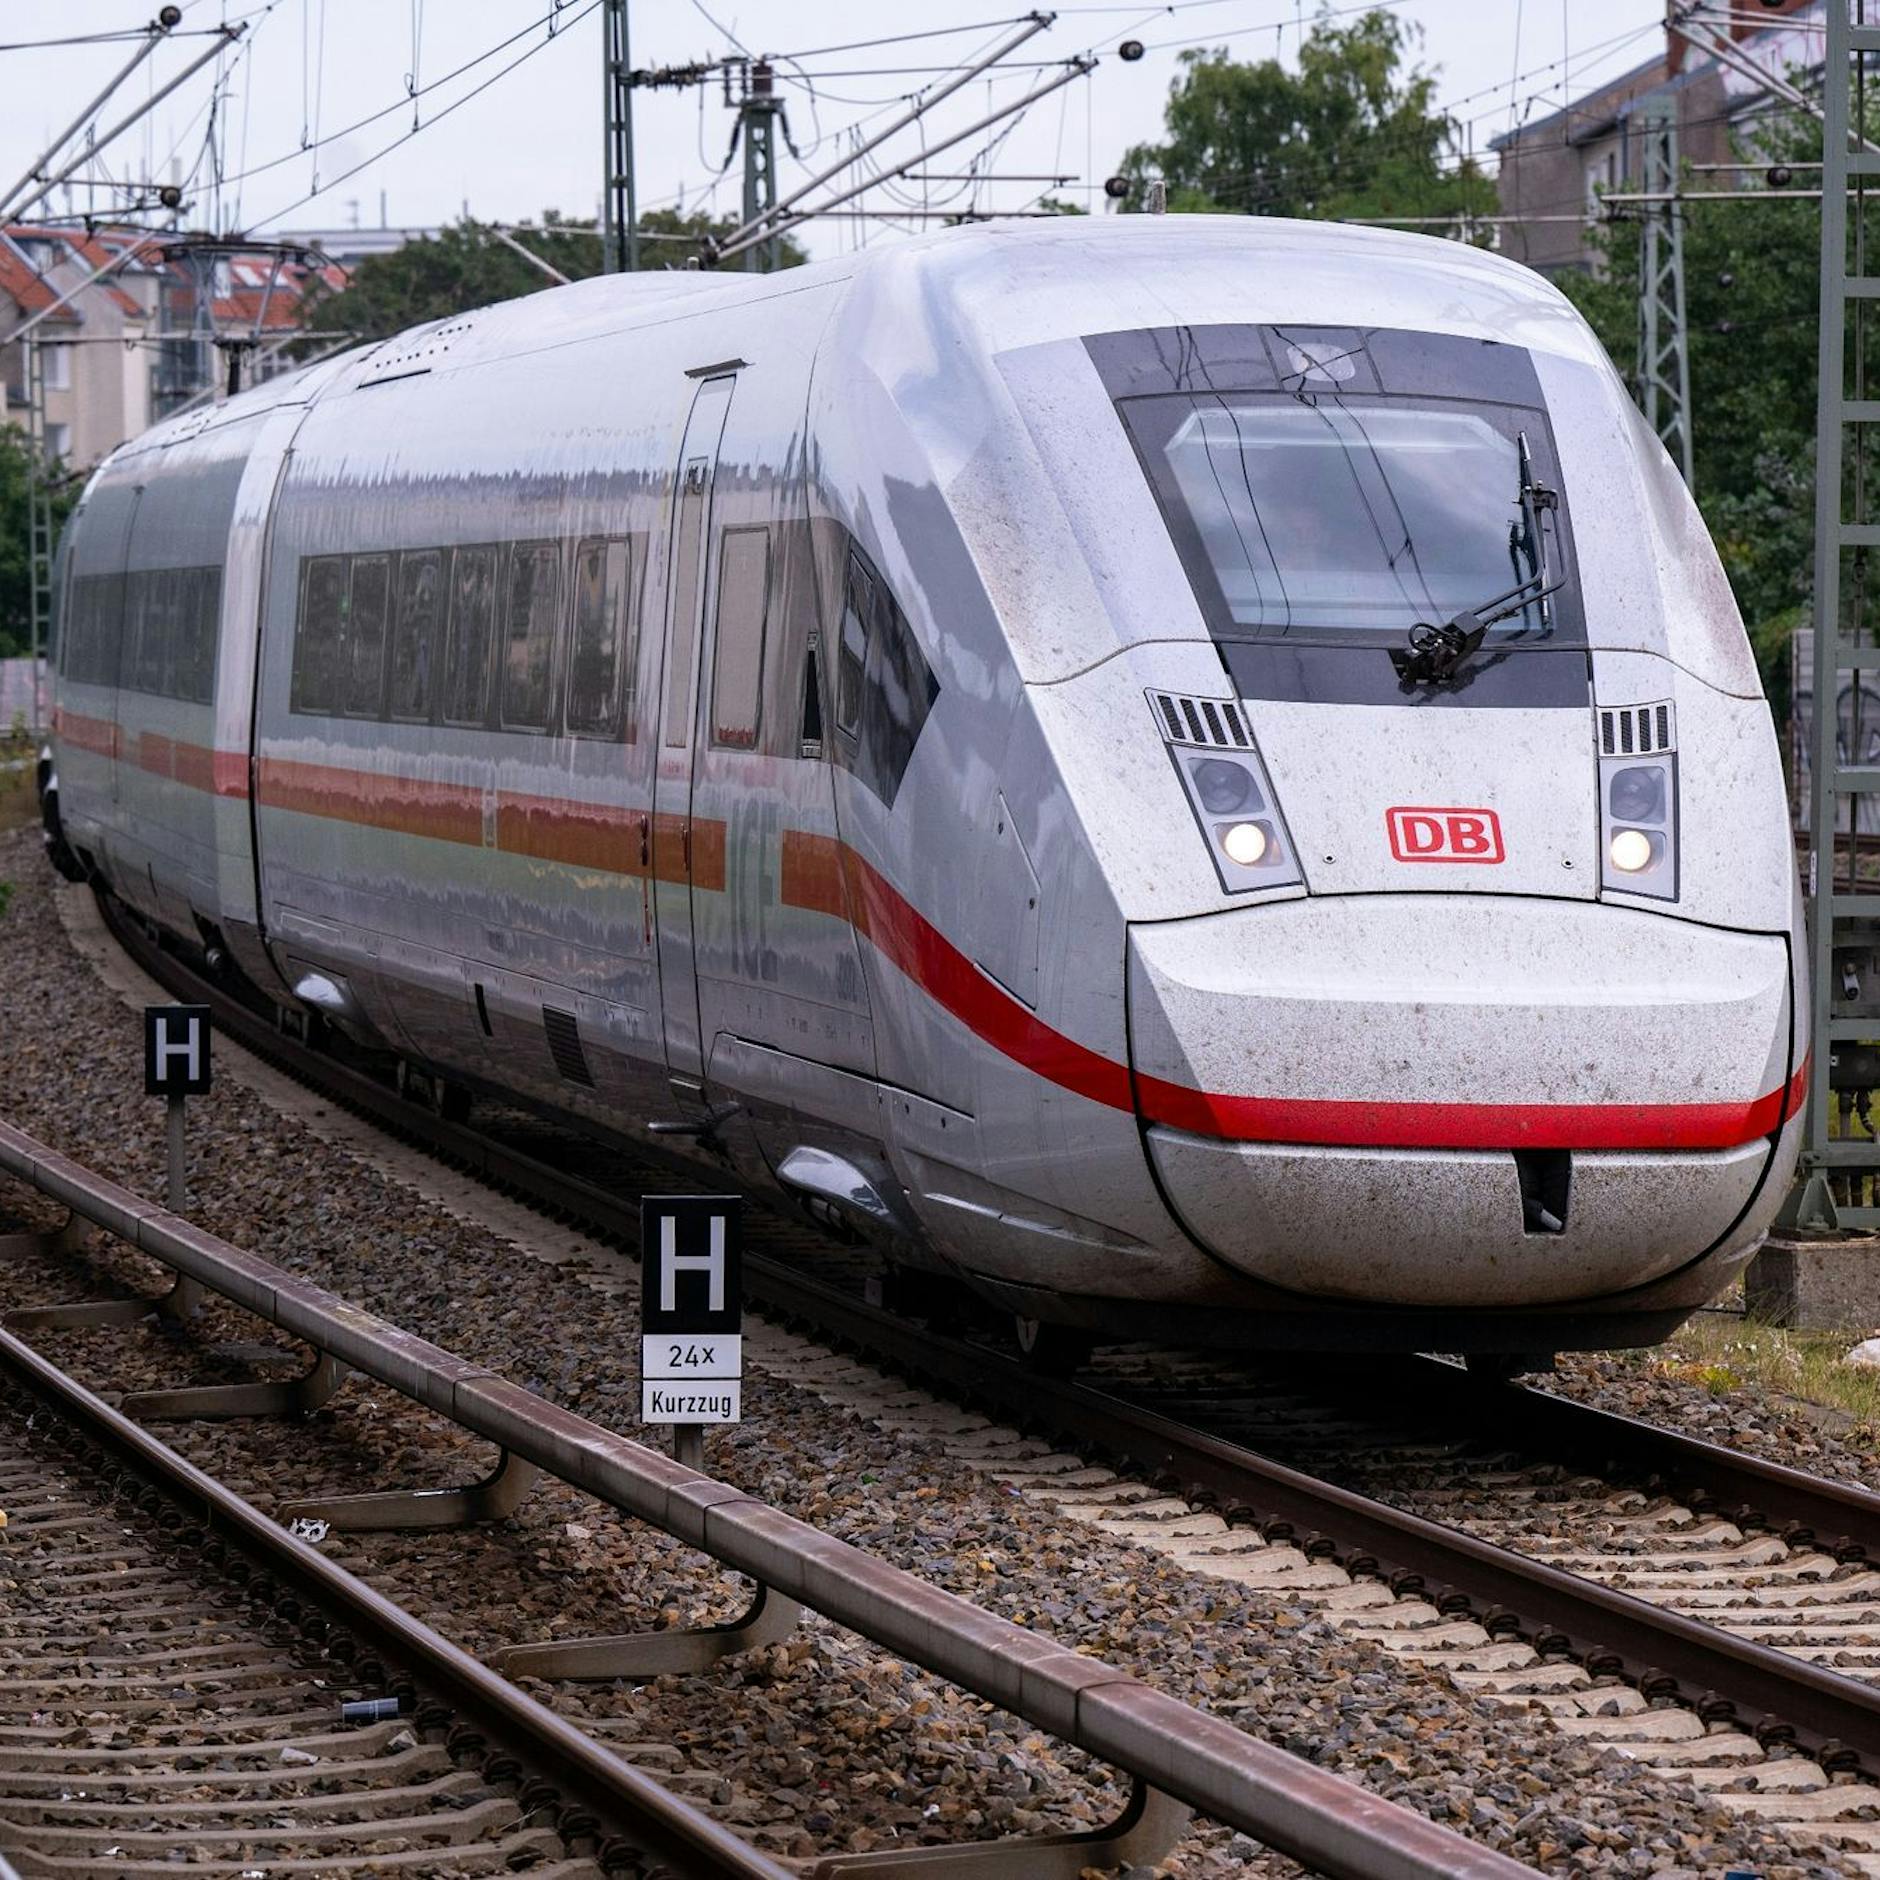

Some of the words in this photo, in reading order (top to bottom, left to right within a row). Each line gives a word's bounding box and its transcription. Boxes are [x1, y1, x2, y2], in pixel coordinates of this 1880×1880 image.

[1400, 815, 1491, 854] DB
[155, 1017, 200, 1081] H
[660, 1215, 726, 1312] H
[668, 1344, 716, 1368] 24x
[651, 1390, 732, 1418] Kurzzug
